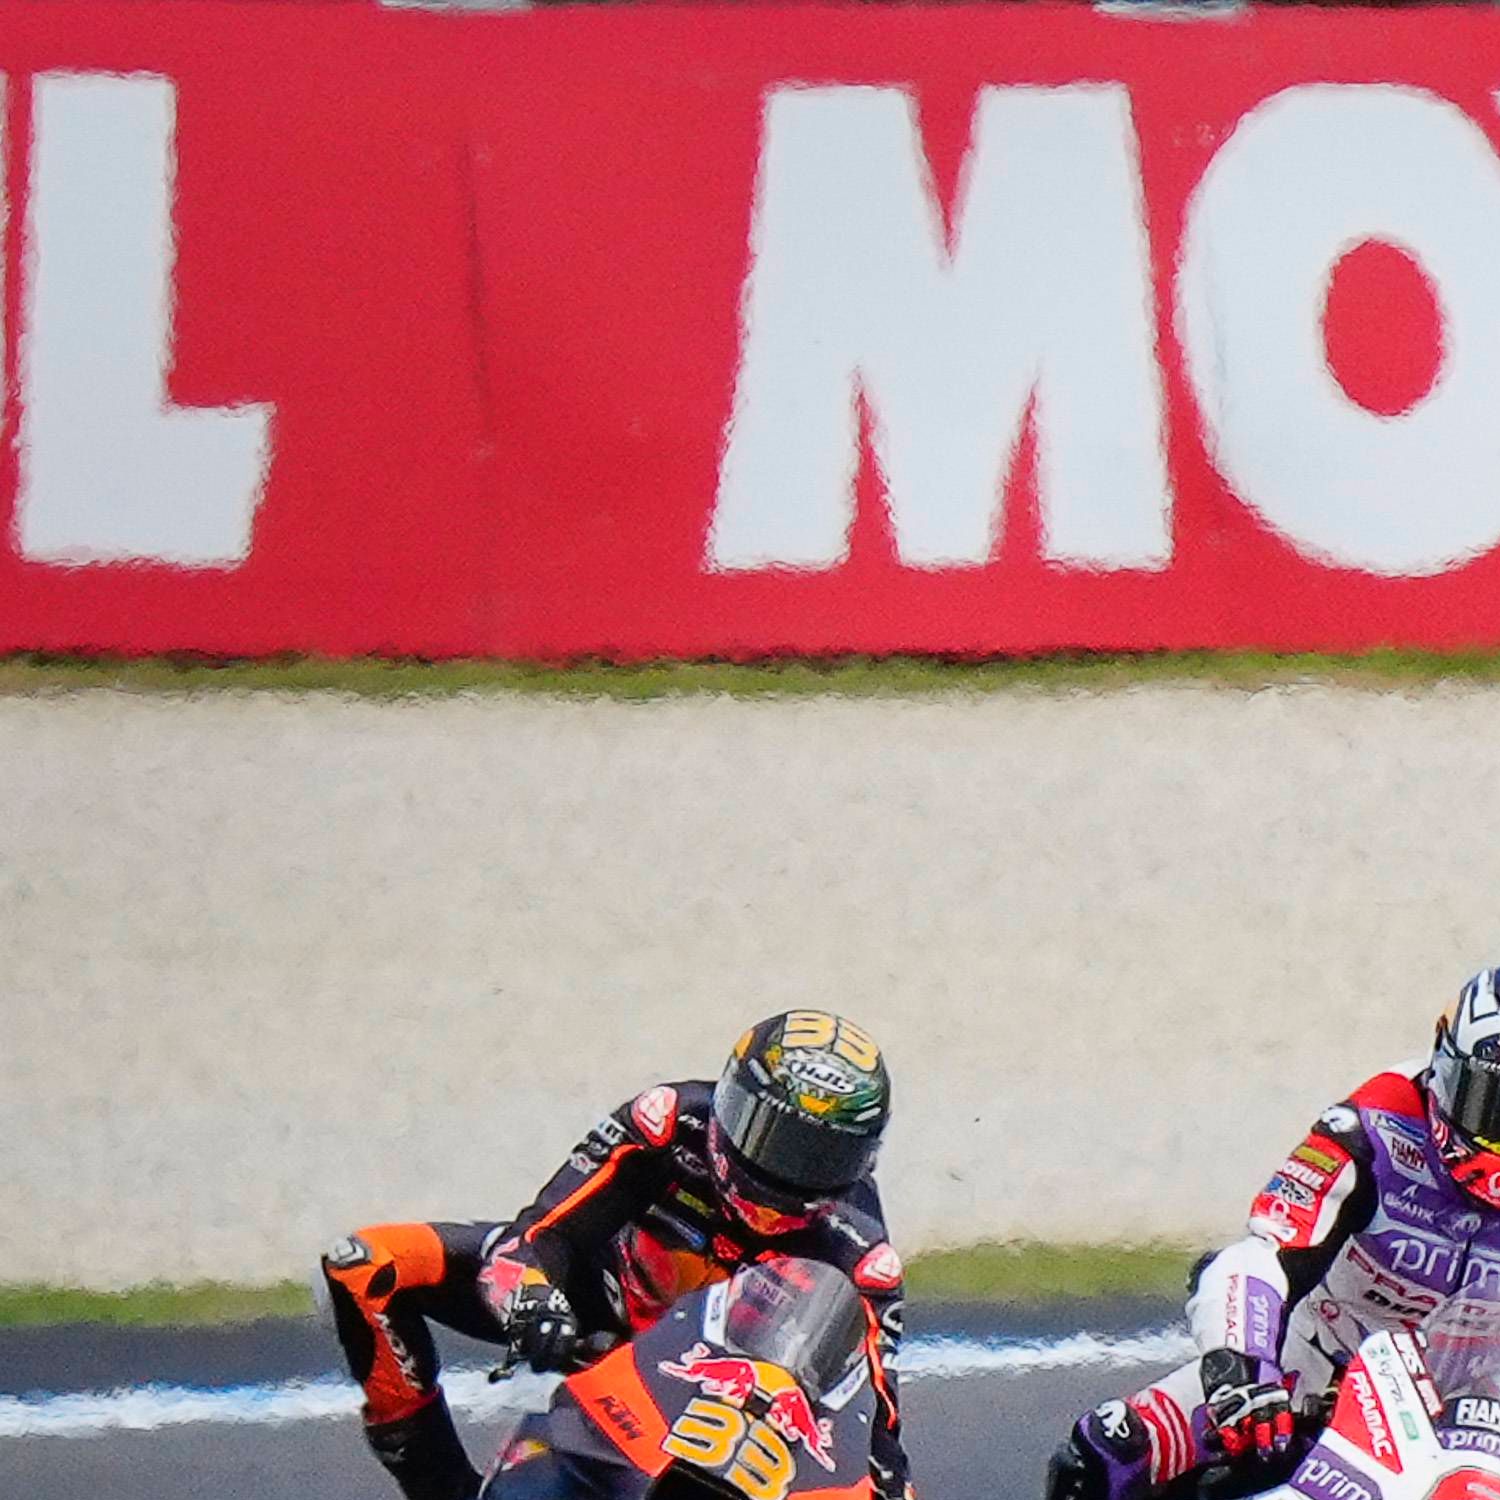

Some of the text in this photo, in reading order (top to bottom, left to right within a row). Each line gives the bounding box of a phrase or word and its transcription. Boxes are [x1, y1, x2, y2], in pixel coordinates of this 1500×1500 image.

[0, 70, 274, 570] L
[783, 1012, 879, 1072] 33
[1348, 1370, 1393, 1458] PRAMAC
